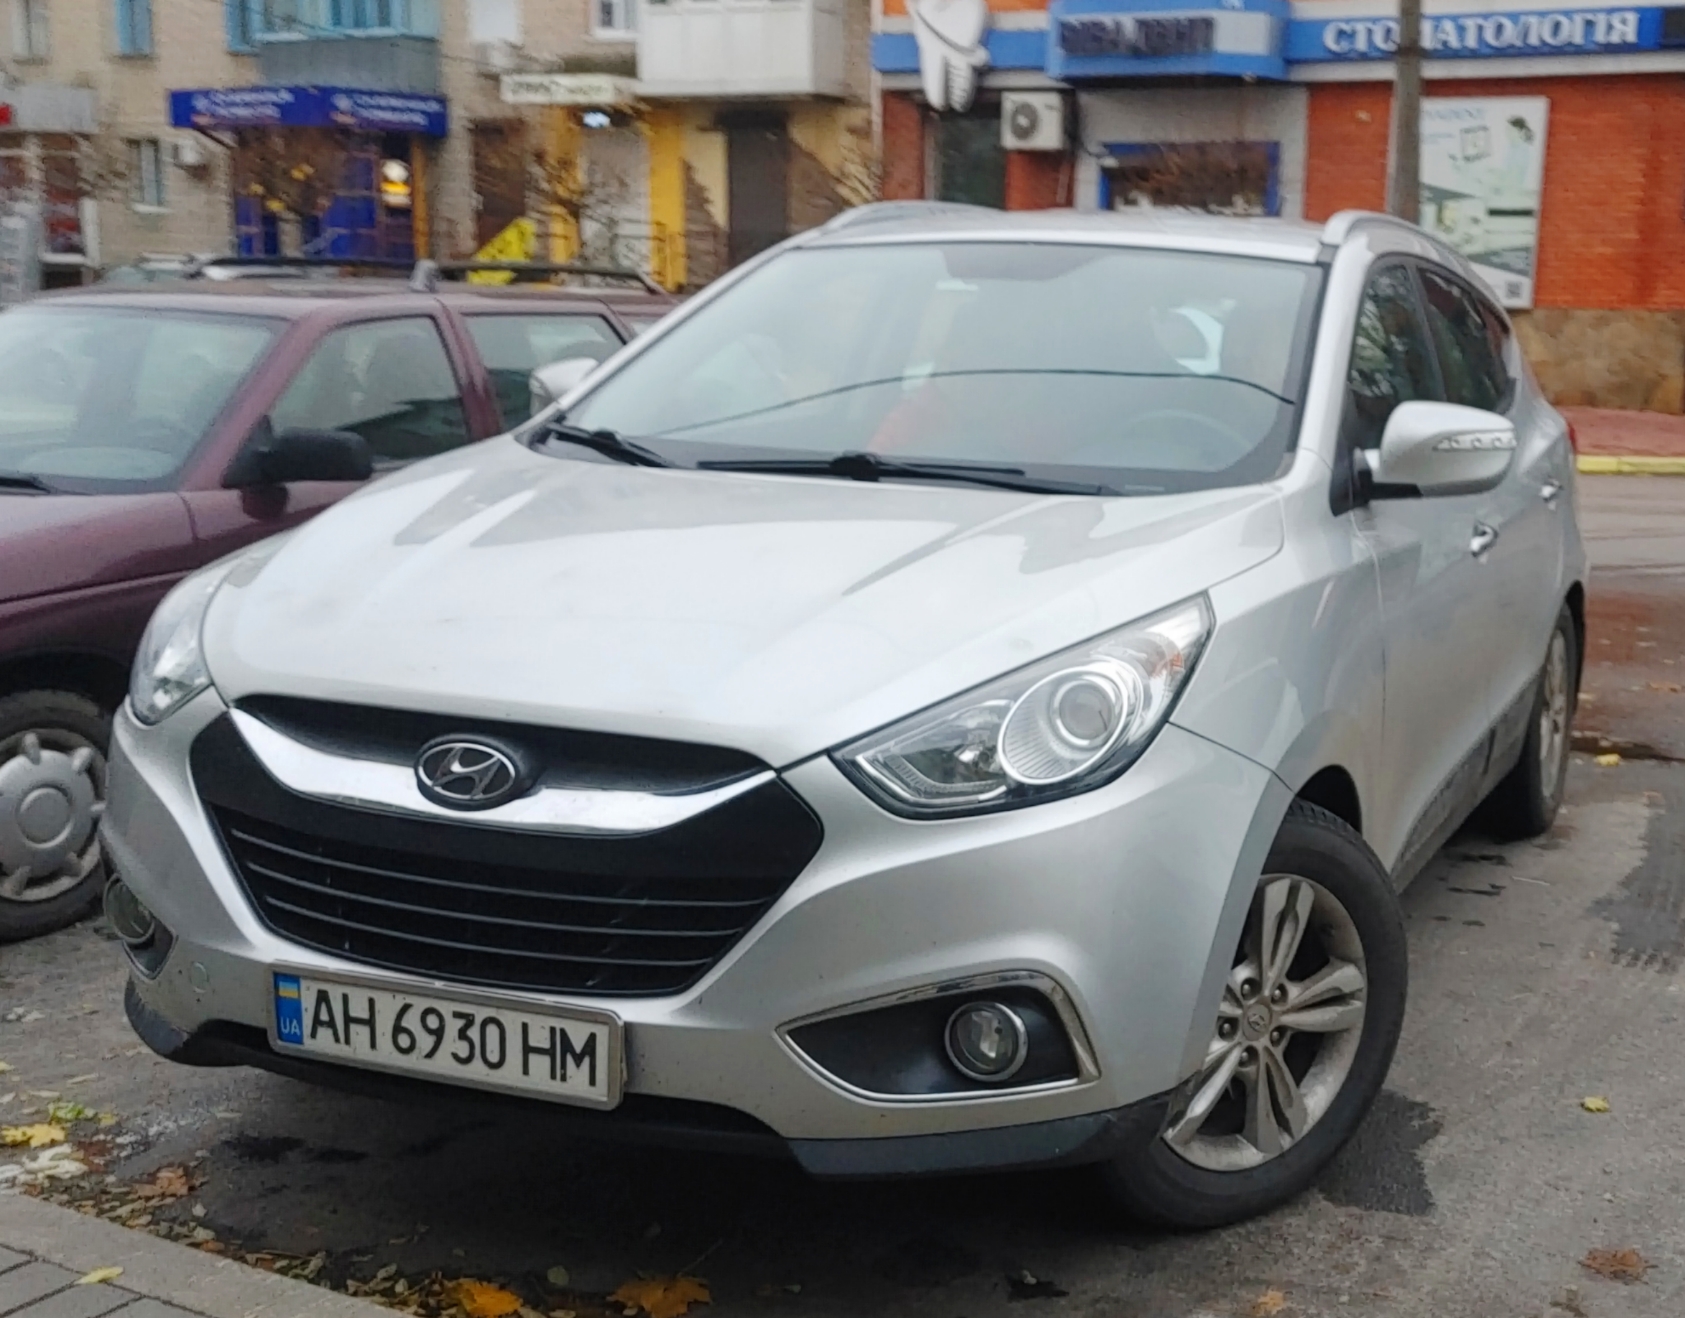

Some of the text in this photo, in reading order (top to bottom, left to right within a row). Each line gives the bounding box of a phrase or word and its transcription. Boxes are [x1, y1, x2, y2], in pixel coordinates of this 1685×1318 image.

[280, 1018, 300, 1036] UA
[310, 989, 597, 1087] AH 6930 HM
